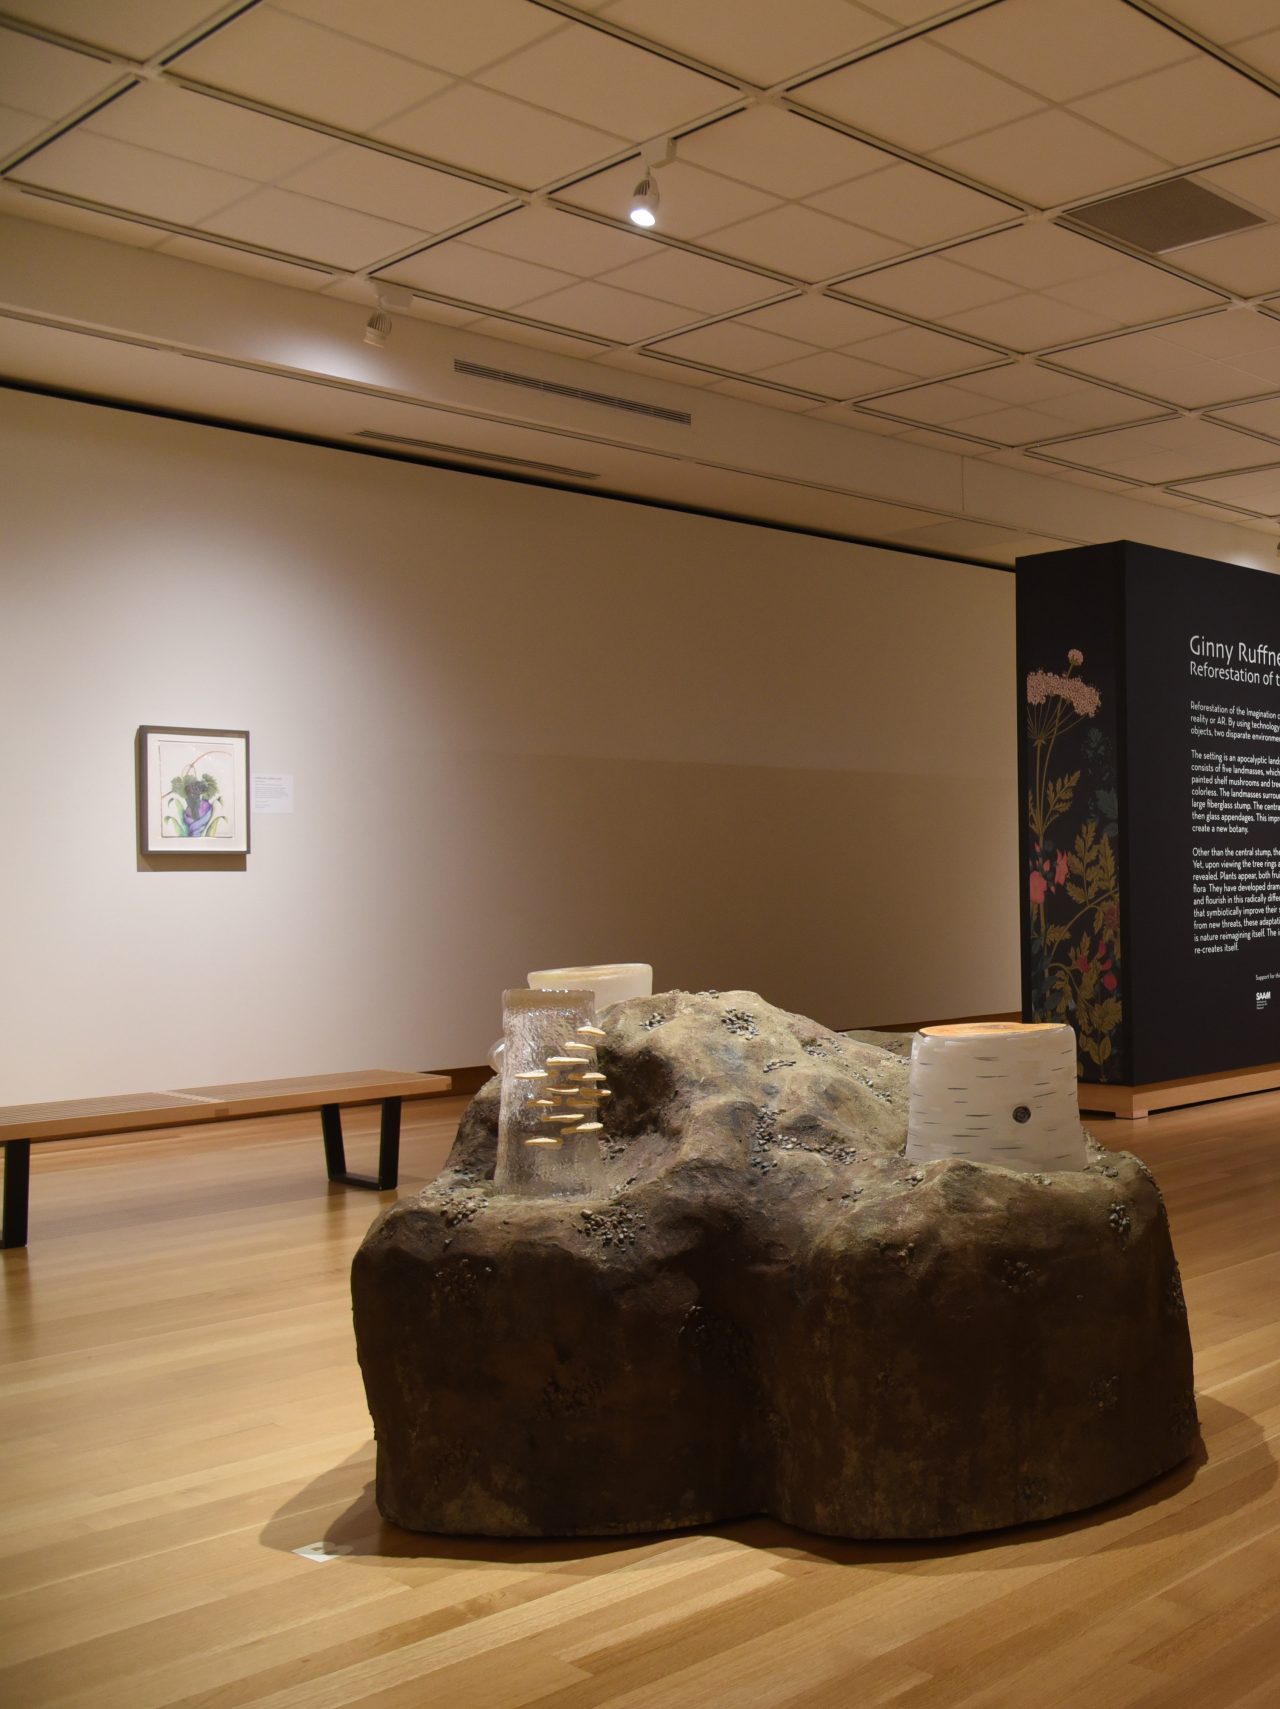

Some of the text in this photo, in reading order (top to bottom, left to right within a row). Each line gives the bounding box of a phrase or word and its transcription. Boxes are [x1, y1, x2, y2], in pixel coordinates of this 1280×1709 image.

[1190, 634, 1234, 665] Ginny
[1190, 661, 1260, 684] Reforestation
[1263, 671, 1273, 686] of
[1190, 701, 1228, 714] Reforestation
[1190, 713, 1208, 727] reality
[1203, 751, 1223, 764] setting
[1191, 762, 1214, 773] consists
[1222, 764, 1232, 774] five
[1191, 774, 1213, 788] painted
[1214, 775, 1228, 786] shelf
[1191, 799, 1206, 811] large
[1207, 799, 1233, 812] fiberglass
[1192, 811, 1205, 821] then
[1206, 811, 1220, 824] glass
[1192, 823, 1210, 833] create
[1192, 847, 1210, 856] Other
[1211, 847, 1224, 856] than
[1205, 862, 1220, 871] upon
[1221, 859, 1241, 871] viewing
[1219, 870, 1237, 880] Plants
[1209, 883, 1223, 895] They
[1223, 882, 1237, 892] have
[1205, 894, 1226, 905] flourish
[1233, 894, 1244, 904] this
[1193, 907, 1205, 917] that
[1206, 906, 1242, 920] symbiotically
[1193, 919, 1208, 930] from
[1200, 931, 1218, 942] nature
[1194, 943, 1223, 955] re-creates
